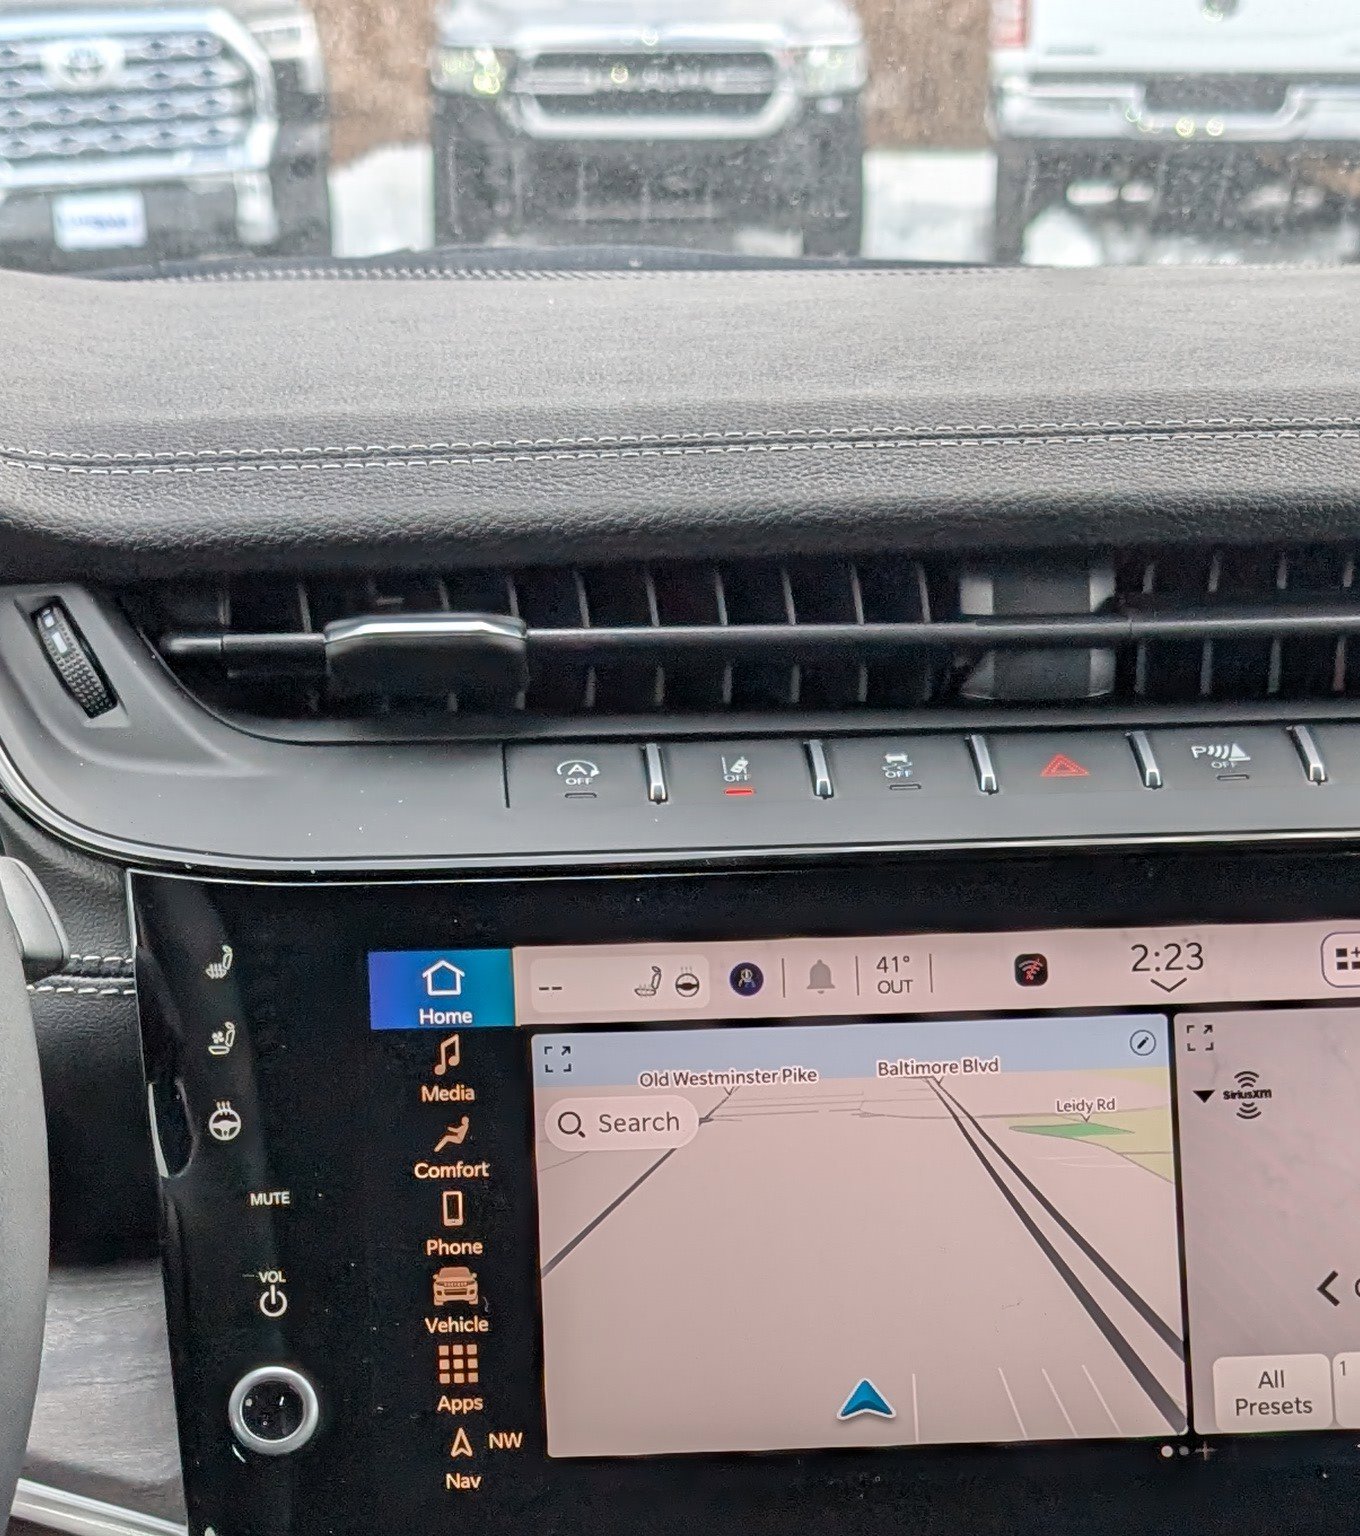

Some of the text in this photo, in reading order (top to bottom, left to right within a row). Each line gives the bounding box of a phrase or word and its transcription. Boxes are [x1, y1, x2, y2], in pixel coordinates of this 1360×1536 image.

[565, 777, 593, 785] OFF
[723, 774, 751, 783] OFF
[885, 769, 913, 779] OFF
[876, 955, 911, 974] 41°
[1130, 942, 1205, 972] 2:23
[877, 979, 914, 995] OUT
[419, 1008, 474, 1025] Home
[877, 1057, 999, 1077] Baltimore Blvd
[639, 1066, 819, 1089] Old Westminster Pike
[420, 1085, 475, 1102] Media
[1056, 1097, 1116, 1114] Leidy Rd
[598, 1112, 680, 1134] Search
[414, 1161, 490, 1179] Comfort
[250, 1191, 291, 1207] MUTE
[425, 1239, 484, 1256] Phone
[258, 1271, 287, 1284] VOL
[425, 1316, 489, 1333] Vehicle
[1340, 1360, 1347, 1376] 1
[1258, 1369, 1285, 1390] All
[436, 1396, 484, 1415] Apps
[1234, 1396, 1313, 1417] Presets
[488, 1432, 523, 1450] NW
[445, 1472, 482, 1490] Nav
